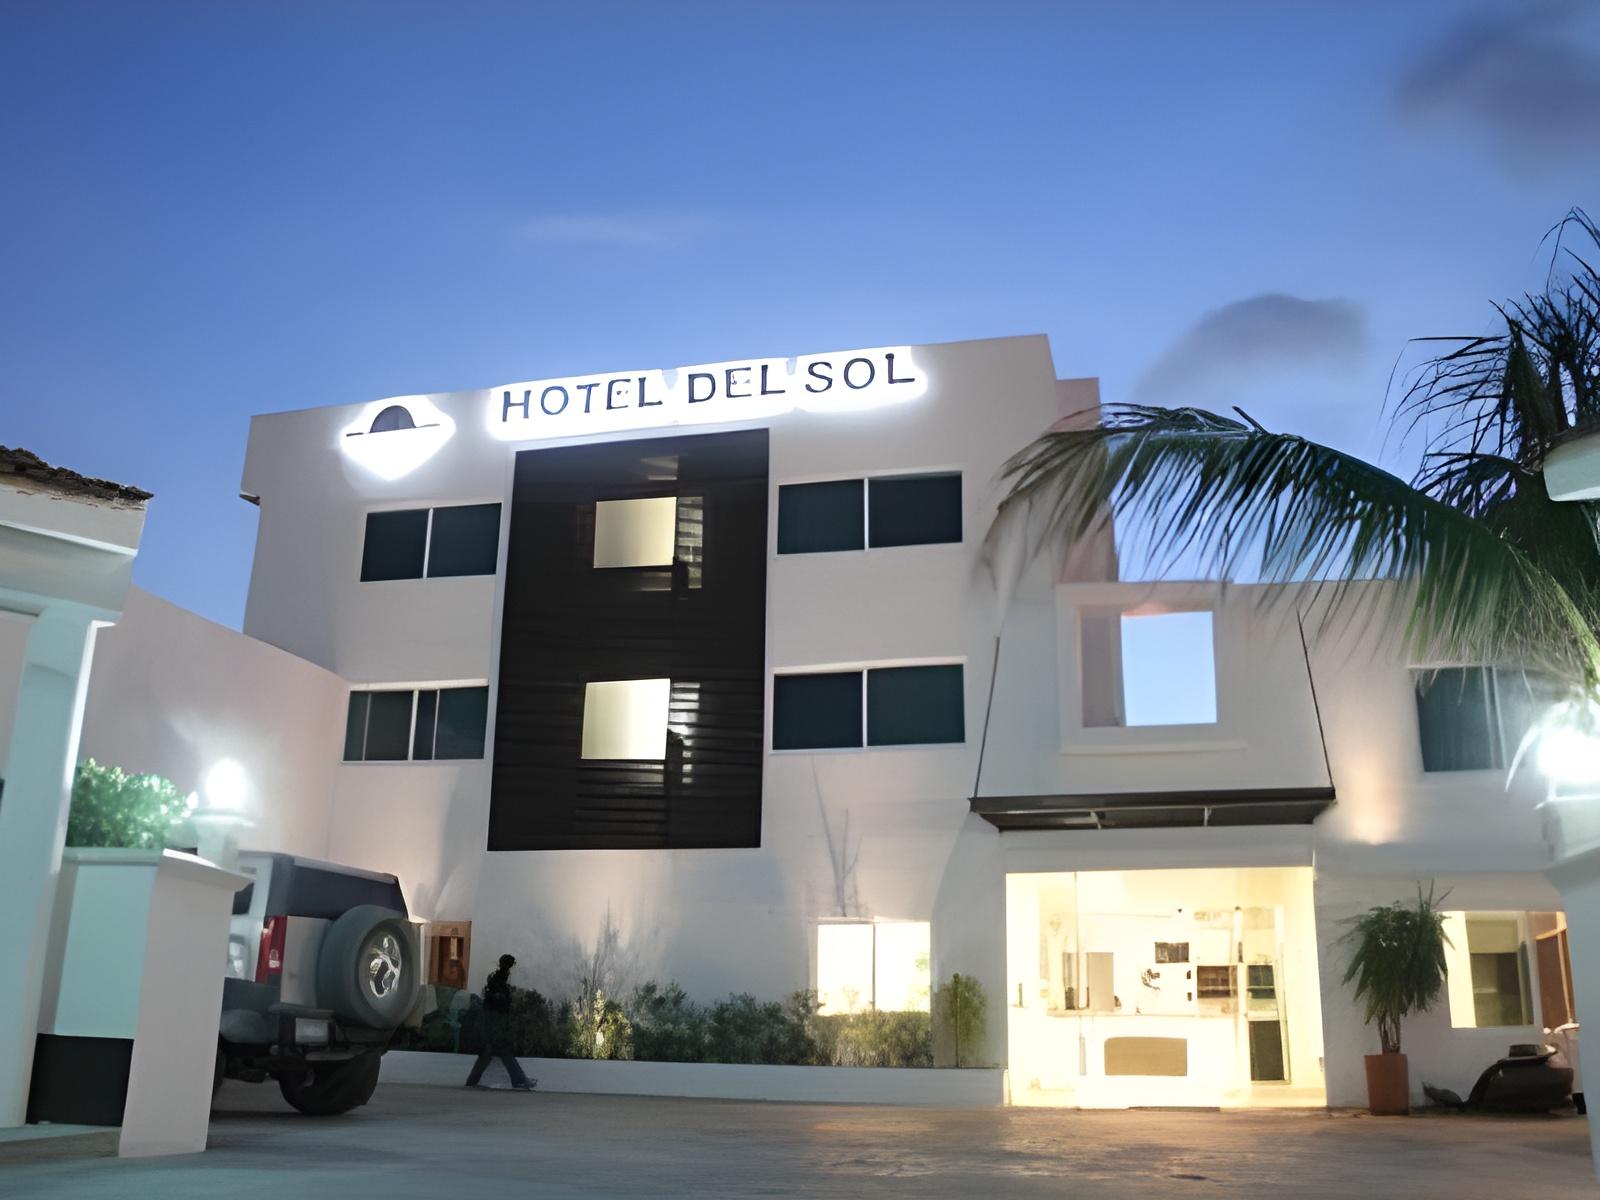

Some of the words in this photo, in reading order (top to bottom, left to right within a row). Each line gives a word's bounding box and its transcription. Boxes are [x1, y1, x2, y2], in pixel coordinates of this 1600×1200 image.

[502, 377, 663, 422] HOTEL
[688, 364, 786, 404] DEL
[805, 353, 916, 393] SOL
